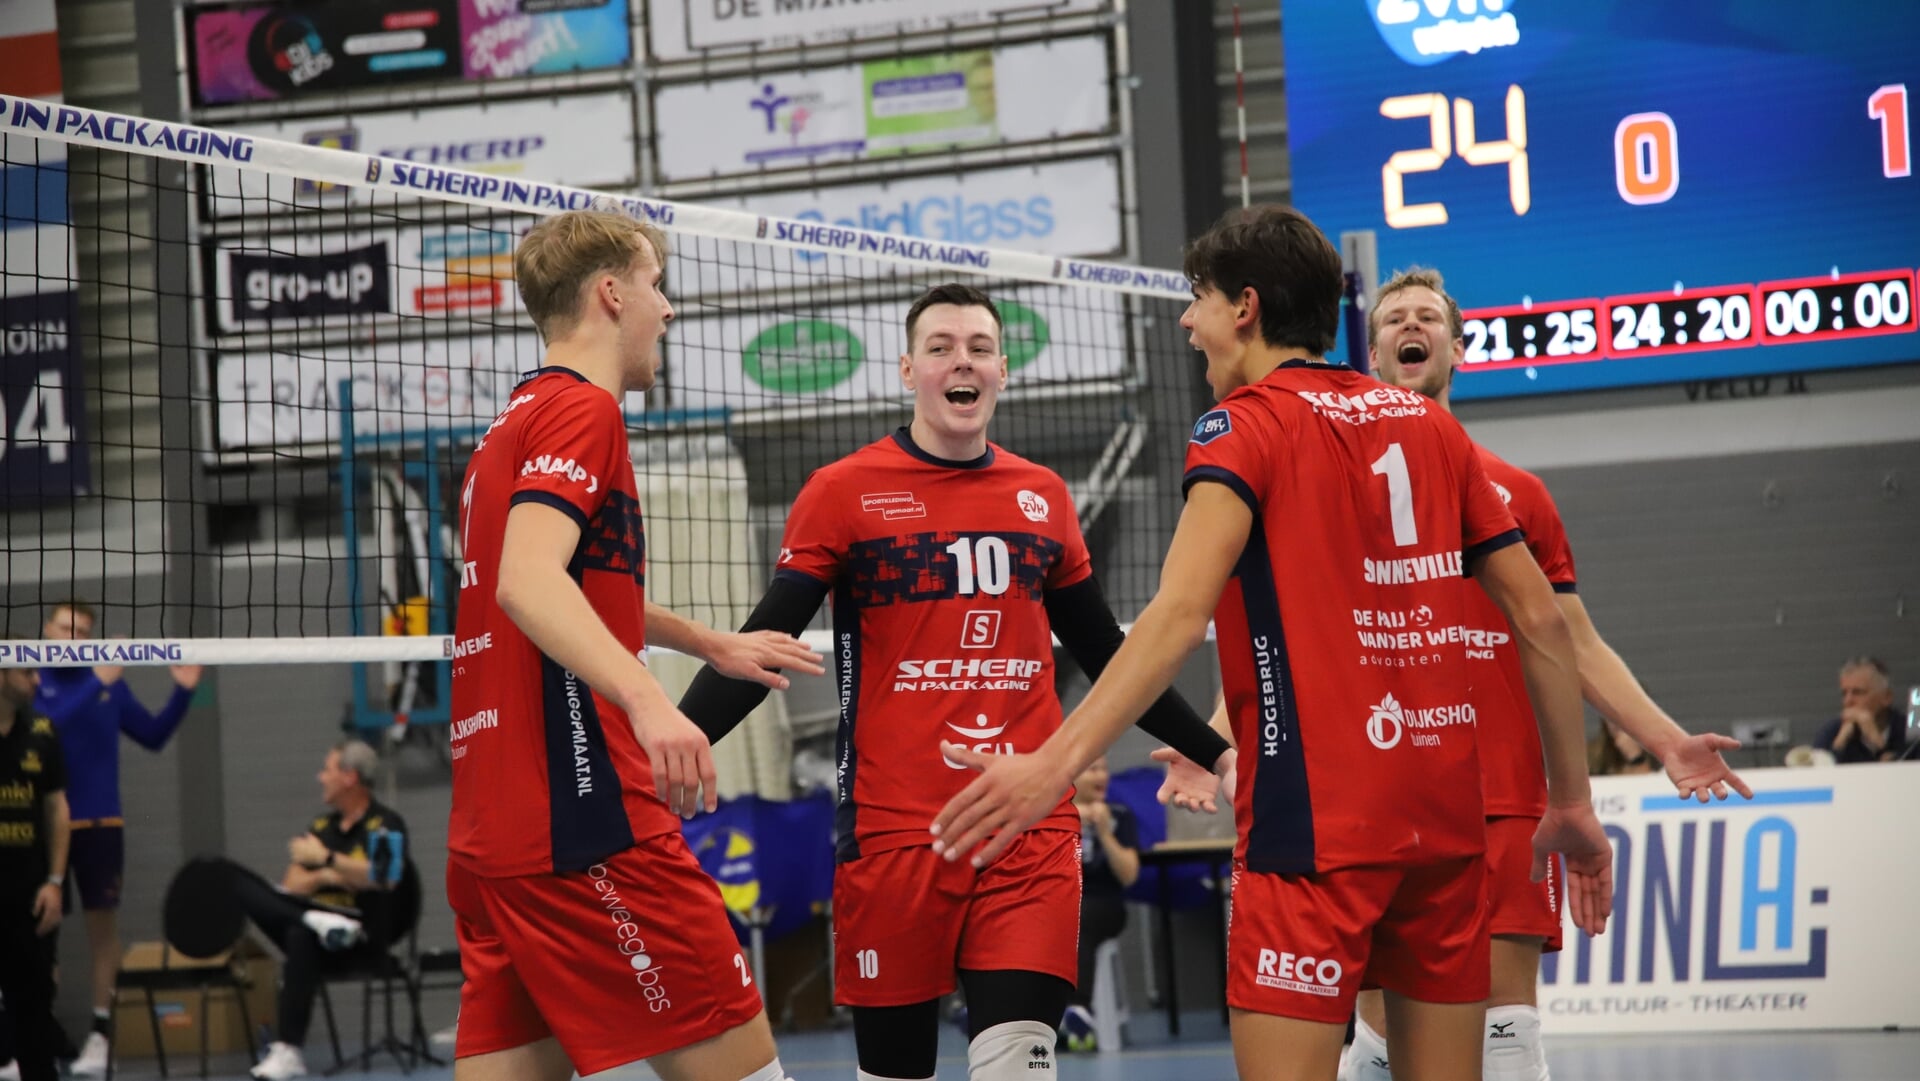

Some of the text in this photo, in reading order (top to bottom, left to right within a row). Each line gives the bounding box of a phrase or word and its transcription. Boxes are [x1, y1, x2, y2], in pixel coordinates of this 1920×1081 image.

[11, 101, 253, 163] IN PACKAGING
[1868, 84, 1912, 178] 1
[1379, 83, 1531, 229] 24
[1614, 111, 1680, 206] 0
[390, 163, 498, 199] SCHERP
[502, 181, 530, 204] IN
[774, 220, 991, 268] SCHERP IN PACKAGING
[246, 263, 374, 309] gro-up
[1067, 262, 1131, 285] SCHERP
[1132, 271, 1149, 287] IN
[1371, 442, 1418, 547] 1
[946, 536, 1010, 596] 10
[971, 615, 991, 644] S
[1353, 609, 1373, 627] DE
[16, 645, 41, 663] IN
[46, 644, 182, 663] PACKAGING
[896, 658, 1042, 679] SCHERP
[894, 680, 1030, 692] IN PACKAGING
[1253, 635, 1279, 757] HOGEBRUG
[732, 953, 752, 987] 2
[856, 949, 879, 979] 10
[1257, 947, 1343, 986] RECO
[1549, 992, 1807, 1015] CULTUUR THEATER
